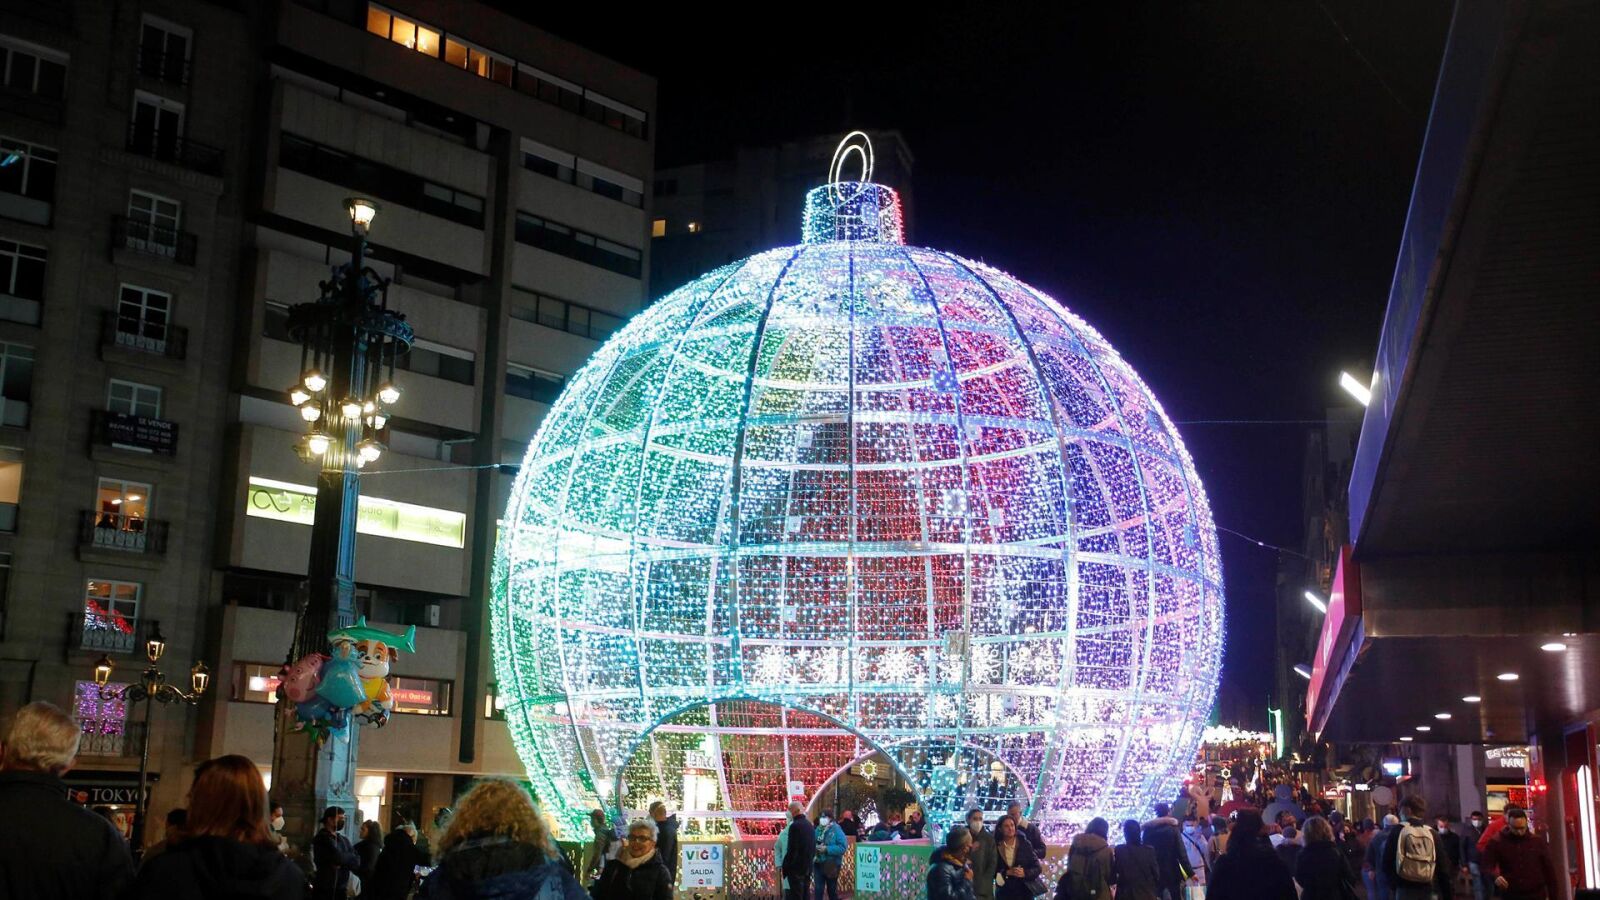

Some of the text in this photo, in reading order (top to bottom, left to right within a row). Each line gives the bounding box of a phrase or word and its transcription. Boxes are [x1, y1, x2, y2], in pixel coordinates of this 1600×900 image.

[148, 418, 172, 430] VENDE
[91, 788, 147, 802] TOKYO
[690, 868, 714, 876] SALIDA
